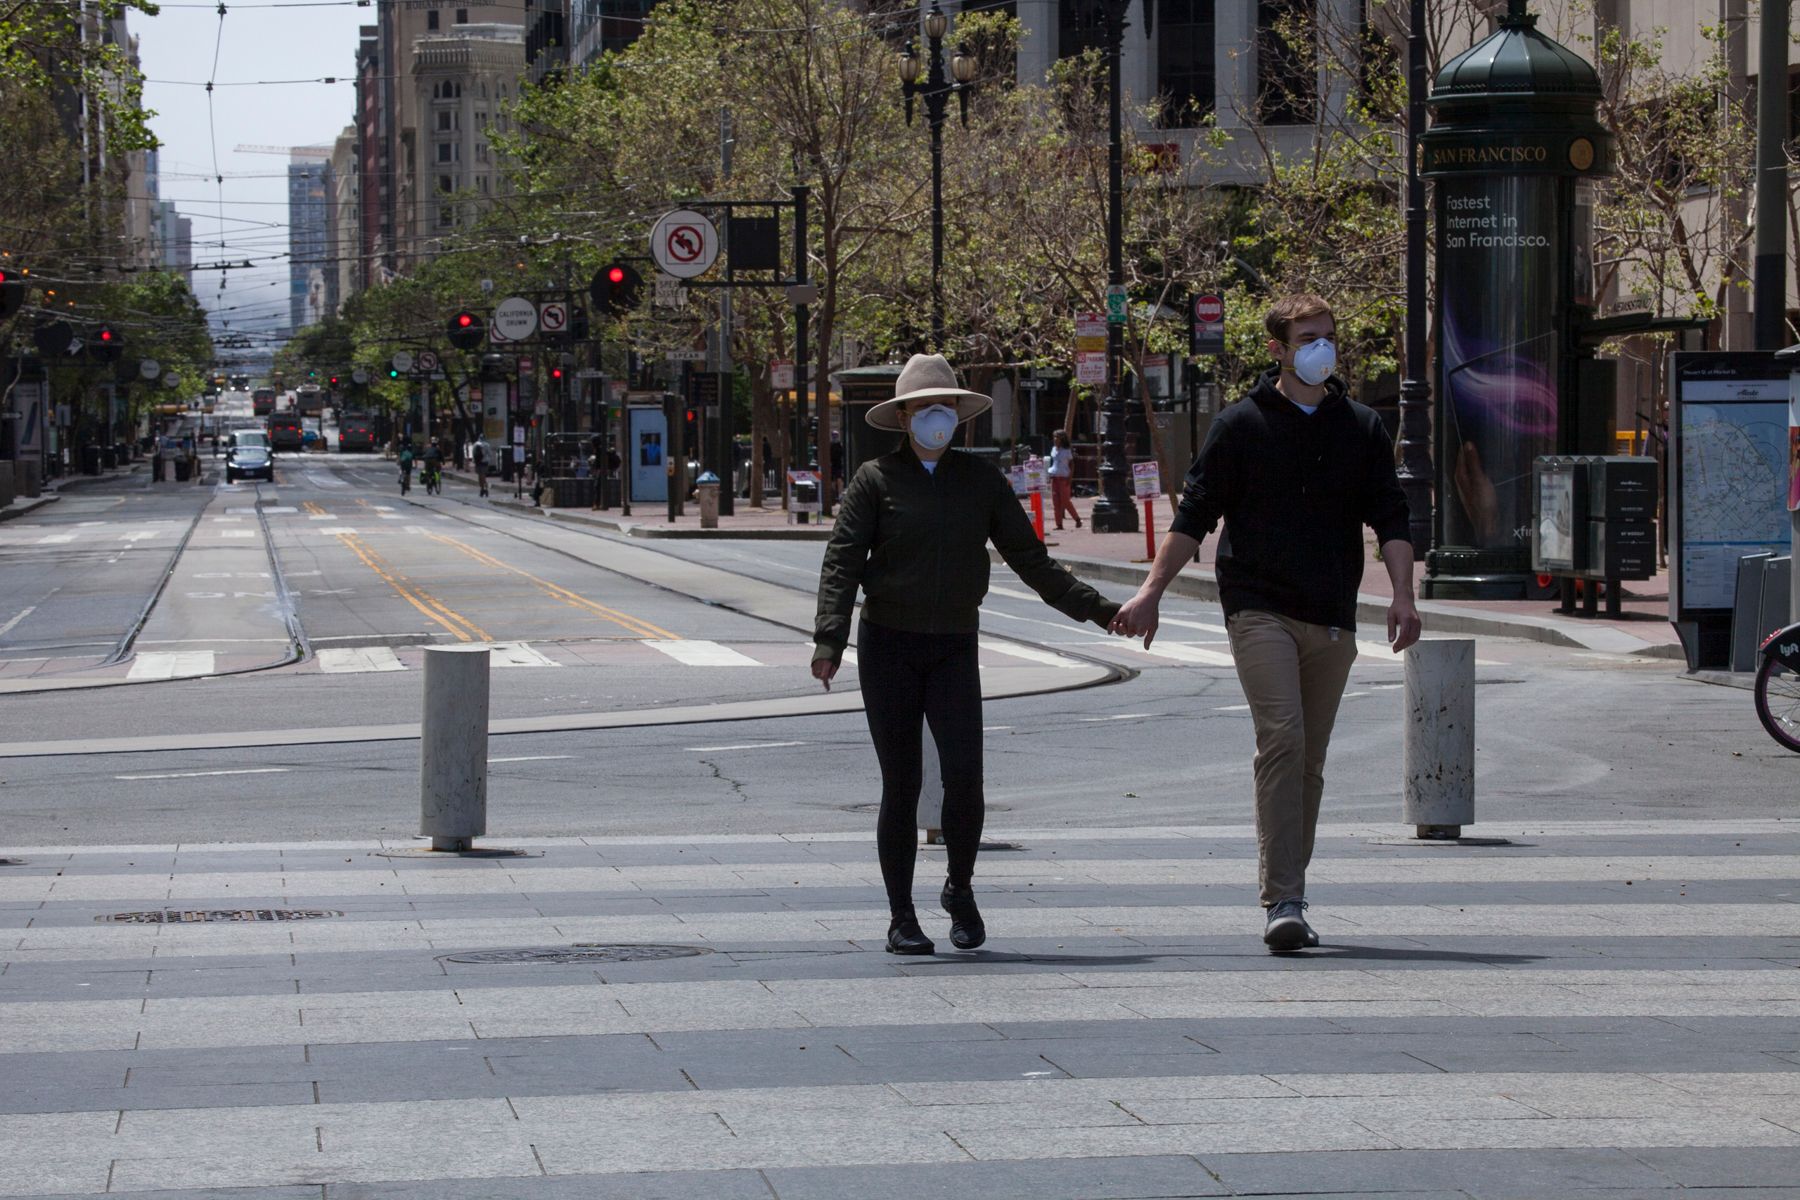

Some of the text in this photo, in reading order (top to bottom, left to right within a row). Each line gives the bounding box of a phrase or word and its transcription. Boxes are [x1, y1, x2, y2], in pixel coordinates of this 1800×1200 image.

[406, 0, 443, 10] HOBART
[1433, 145, 1548, 165] SAN FRANCISCO
[1446, 195, 1491, 211] Fastest
[1446, 213, 1518, 230] Internet in
[1446, 232, 1551, 249] San Francisco.
[499, 310, 534, 318] CALIFORNIA
[1779, 643, 1799, 658] lyft
